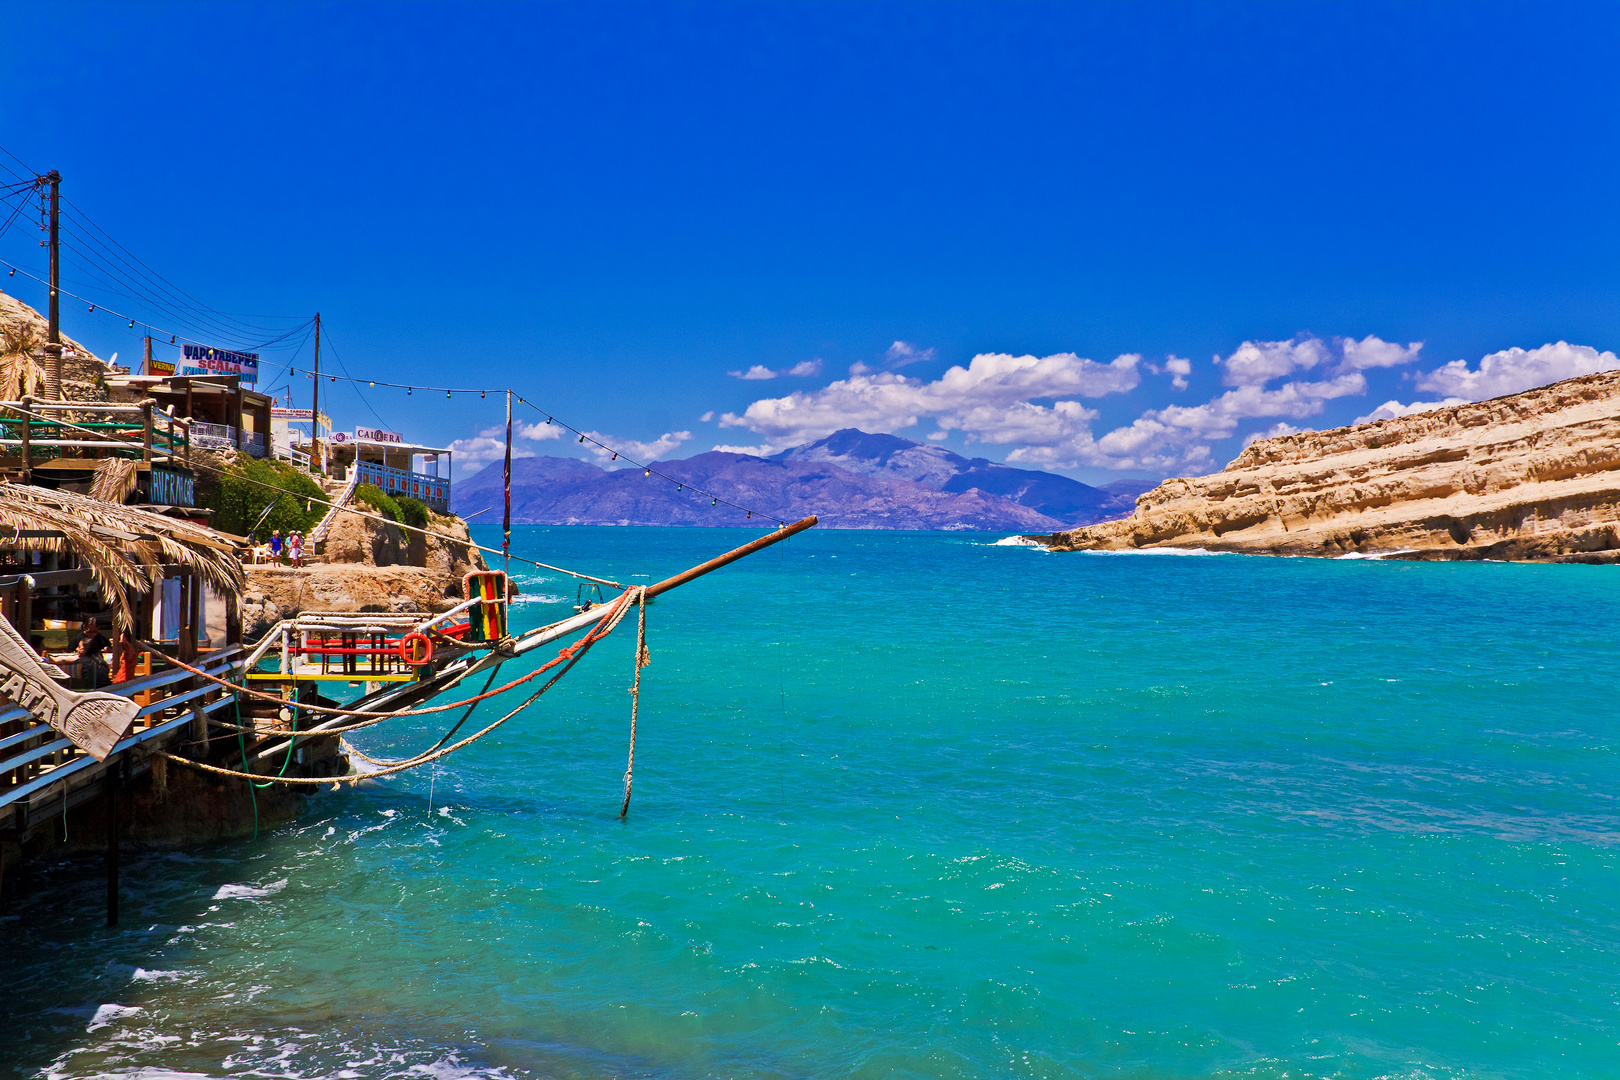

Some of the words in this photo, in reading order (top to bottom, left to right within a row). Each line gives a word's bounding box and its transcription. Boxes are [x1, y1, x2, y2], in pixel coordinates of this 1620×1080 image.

[183, 366, 208, 376] FISH
[198, 359, 242, 373] SCALA
[358, 429, 401, 443] CALDERA
